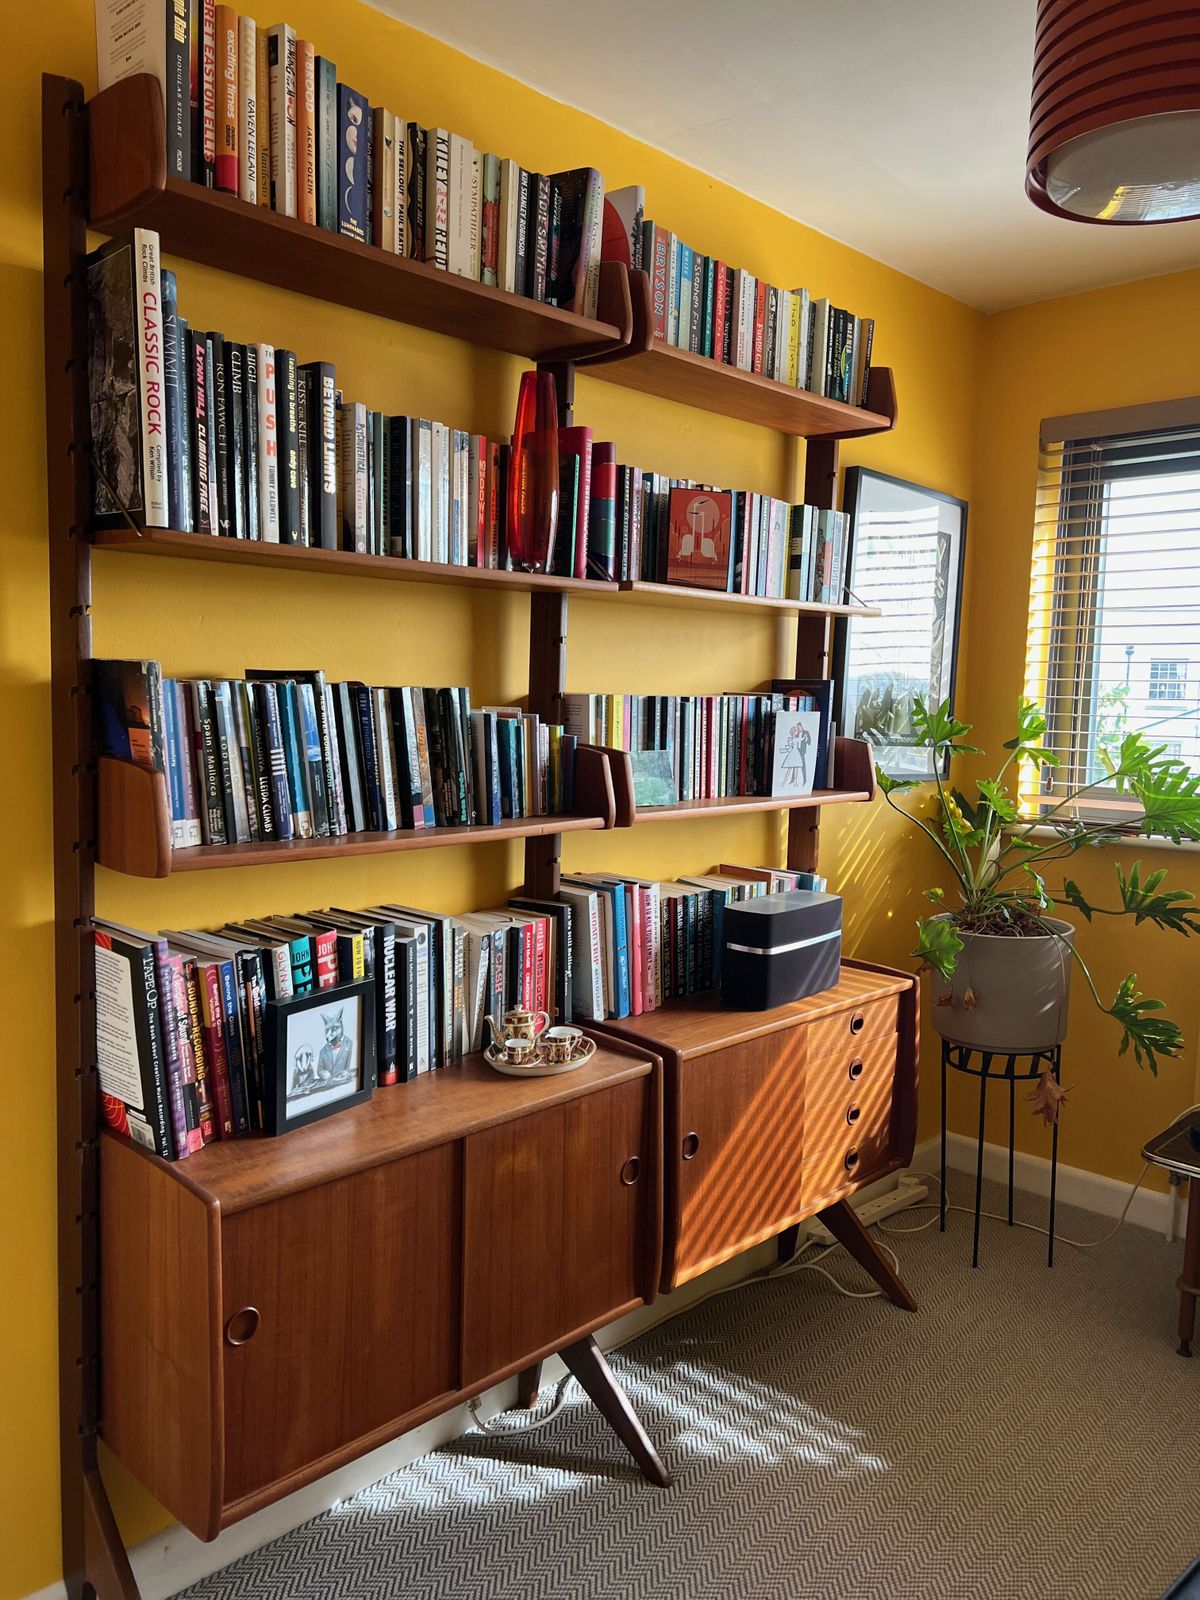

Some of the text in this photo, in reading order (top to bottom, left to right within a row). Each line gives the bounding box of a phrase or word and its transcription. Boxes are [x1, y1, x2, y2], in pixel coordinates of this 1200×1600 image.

[174, 15, 187, 44] Bain
[204, 0, 214, 41] BRET
[204, 45, 214, 114] EASTON
[225, 29, 237, 118] exciting times
[306, 62, 314, 112] BROOD
[248, 98, 256, 137] RAVEN
[204, 119, 214, 163] ELLIS
[248, 139, 256, 181] LEILANI
[260, 146, 269, 197] Manifesto
[436, 137, 447, 187] KILEY
[435, 228, 447, 266] REID
[519, 219, 527, 257] ROBINSON
[536, 182, 548, 274] ZADIE SMITH
[654, 244, 666, 315] BRYSON
[693, 265, 701, 308] Stephen
[164, 313, 179, 392] SUMMIT
[756, 323, 764, 353] Funny
[143, 292, 162, 436] CLASSIC ROCK
[231, 351, 241, 394] CLIMB
[247, 352, 256, 383] HIGH
[216, 363, 226, 454] RON FAWCETT
[265, 363, 277, 457] PUSH
[289, 392, 295, 401] to
[297, 380, 306, 405] KISS
[195, 344, 208, 512] LYNN HILL CLIMBING FREE
[298, 406, 304, 418] OR
[298, 420, 306, 445] KILL
[323, 376, 336, 495] BEYOND LIMITS
[356, 423, 365, 474] PSYCHOVERTICAL
[289, 450, 297, 469] andy
[269, 491, 277, 523] CALDWELL
[320, 695, 328, 712] RED
[202, 719, 212, 746] Spain
[321, 713, 329, 734] RIVER
[220, 736, 231, 794] RODELLAR
[323, 735, 331, 761] GORGE
[206, 755, 218, 797] Mallorca
[259, 776, 271, 804] LLEIDA
[262, 804, 272, 833] CLIMBS
[568, 920, 572, 929] We
[277, 951, 290, 983] GLYN
[292, 950, 310, 964] JOHN
[317, 940, 338, 957] JOHN
[317, 953, 339, 989] PE
[383, 934, 396, 1033] NUCLEAR WAR
[174, 977, 188, 1012] Temples
[212, 983, 221, 1008] Behind
[224, 974, 232, 1001] Behind
[228, 1016, 236, 1036] Glass
[178, 1019, 191, 1044] Sound
[186, 980, 197, 1014] SOUND
[192, 1027, 205, 1080] RECORDING
[152, 1061, 160, 1086] Creative
[157, 1104, 166, 1135] Recording,
[160, 1136, 168, 1148] Vol.
